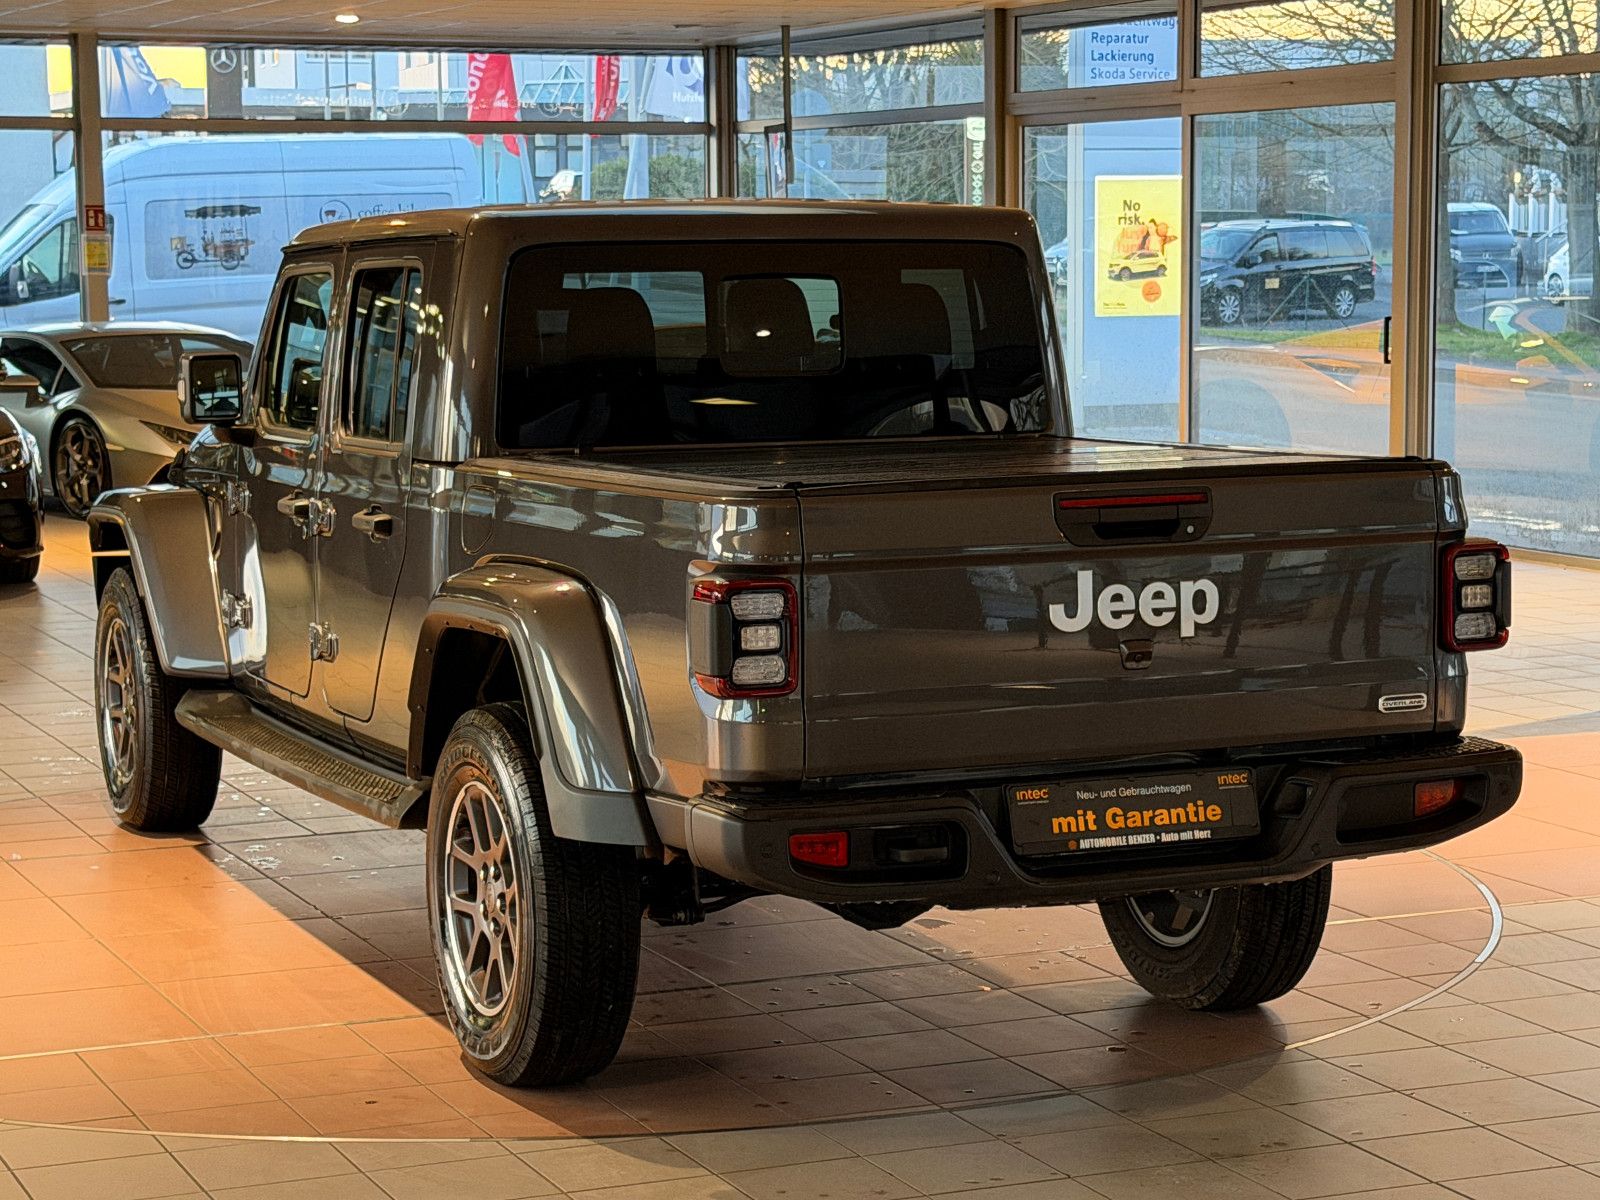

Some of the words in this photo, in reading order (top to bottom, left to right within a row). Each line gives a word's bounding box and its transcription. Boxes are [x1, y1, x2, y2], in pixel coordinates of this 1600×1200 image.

[1091, 32, 1149, 46] Reparatur
[1091, 50, 1154, 65] Lackierung
[1090, 67, 1126, 80] Skoda
[1129, 67, 1170, 80] Service
[1123, 200, 1141, 212] No
[1118, 212, 1145, 226] risk.
[1049, 570, 1219, 638] Jeep
[1217, 772, 1248, 786] intec
[1016, 786, 1049, 801] intec
[1076, 789, 1099, 800] Neu-
[1100, 788, 1118, 799] und
[1119, 783, 1192, 798] Gebrauchtwagen
[1052, 809, 1097, 834] mit
[1105, 800, 1223, 830] Garantie
[1079, 836, 1127, 849] AUTOMOBILE
[1128, 833, 1155, 845] BENZER
[1161, 832, 1179, 842] Auto
[1180, 831, 1193, 841] mit
[1194, 829, 1212, 839] Herz
